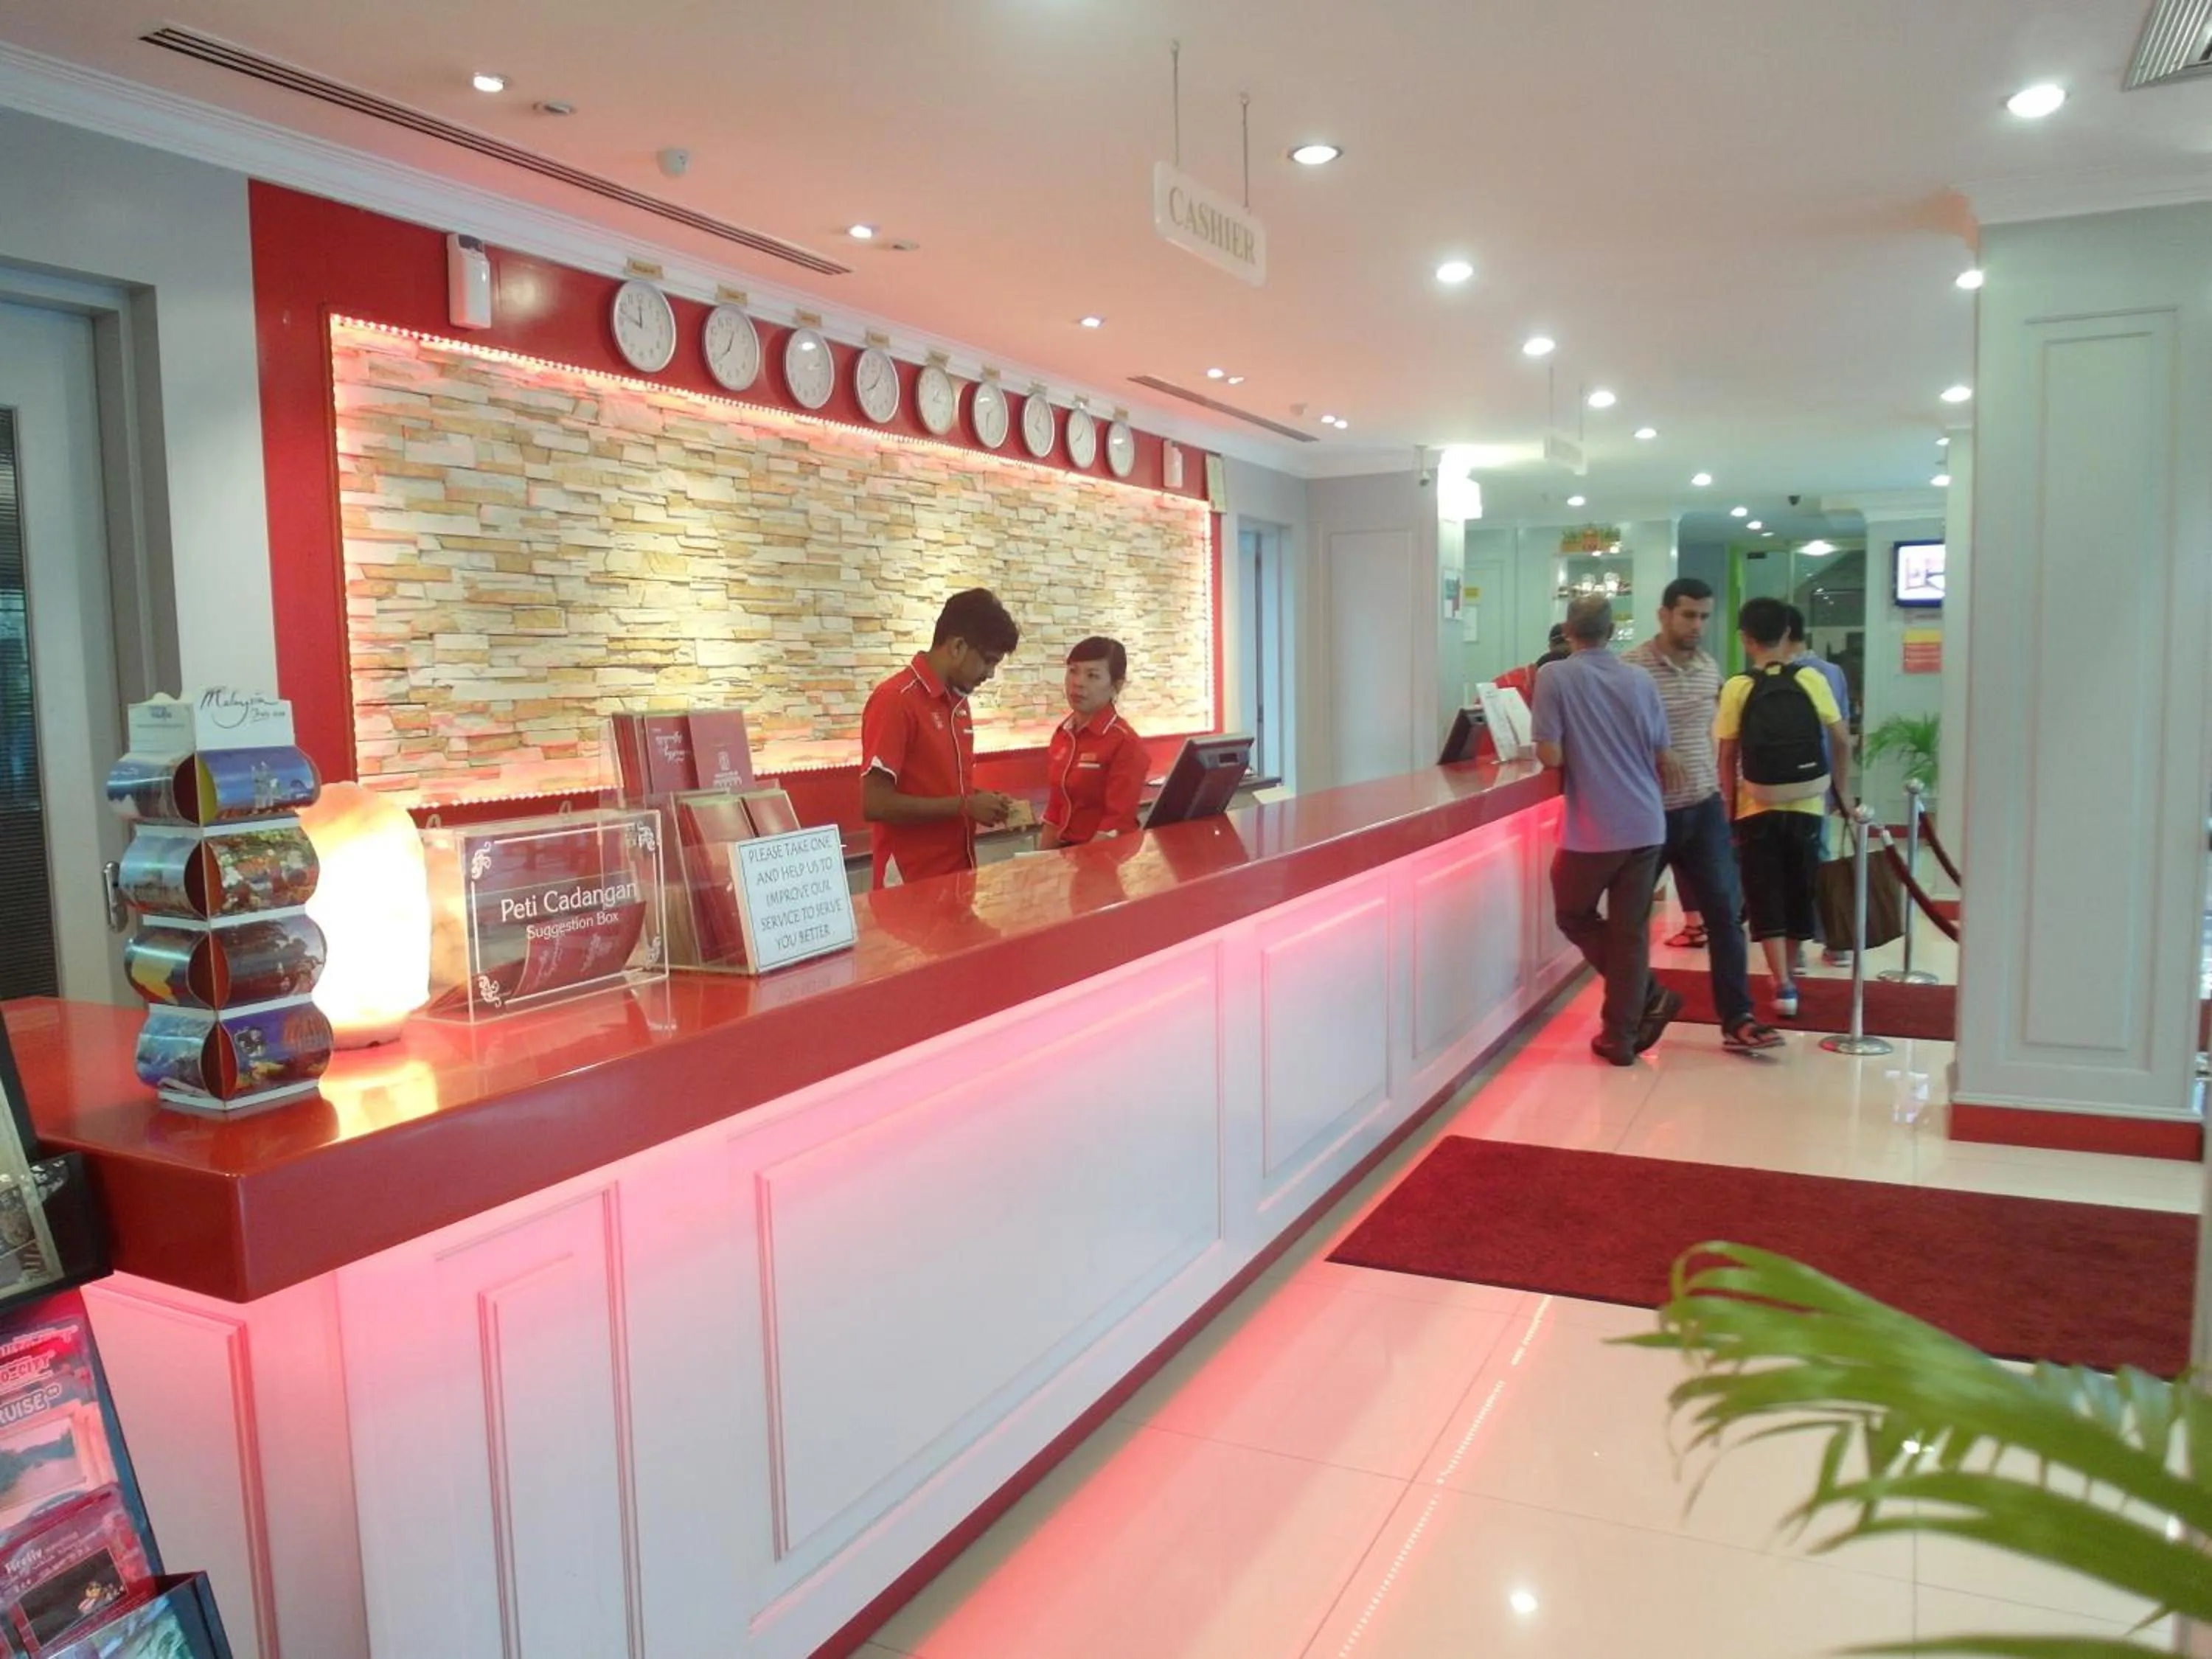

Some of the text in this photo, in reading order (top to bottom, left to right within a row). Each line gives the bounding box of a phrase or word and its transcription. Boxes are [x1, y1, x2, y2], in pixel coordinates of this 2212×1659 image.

[1169, 186, 1257, 266] CASHIER
[748, 835, 832, 863] PLEASE TAKE ONE
[757, 856, 833, 886] AND HELP US TO
[501, 883, 637, 922] Peti Cadangan
[766, 879, 832, 908] IMPROVE OUR
[526, 911, 619, 940] Suggestion Box
[760, 898, 843, 932] SERVICE TO SERVE
[776, 931, 797, 950] YOU
